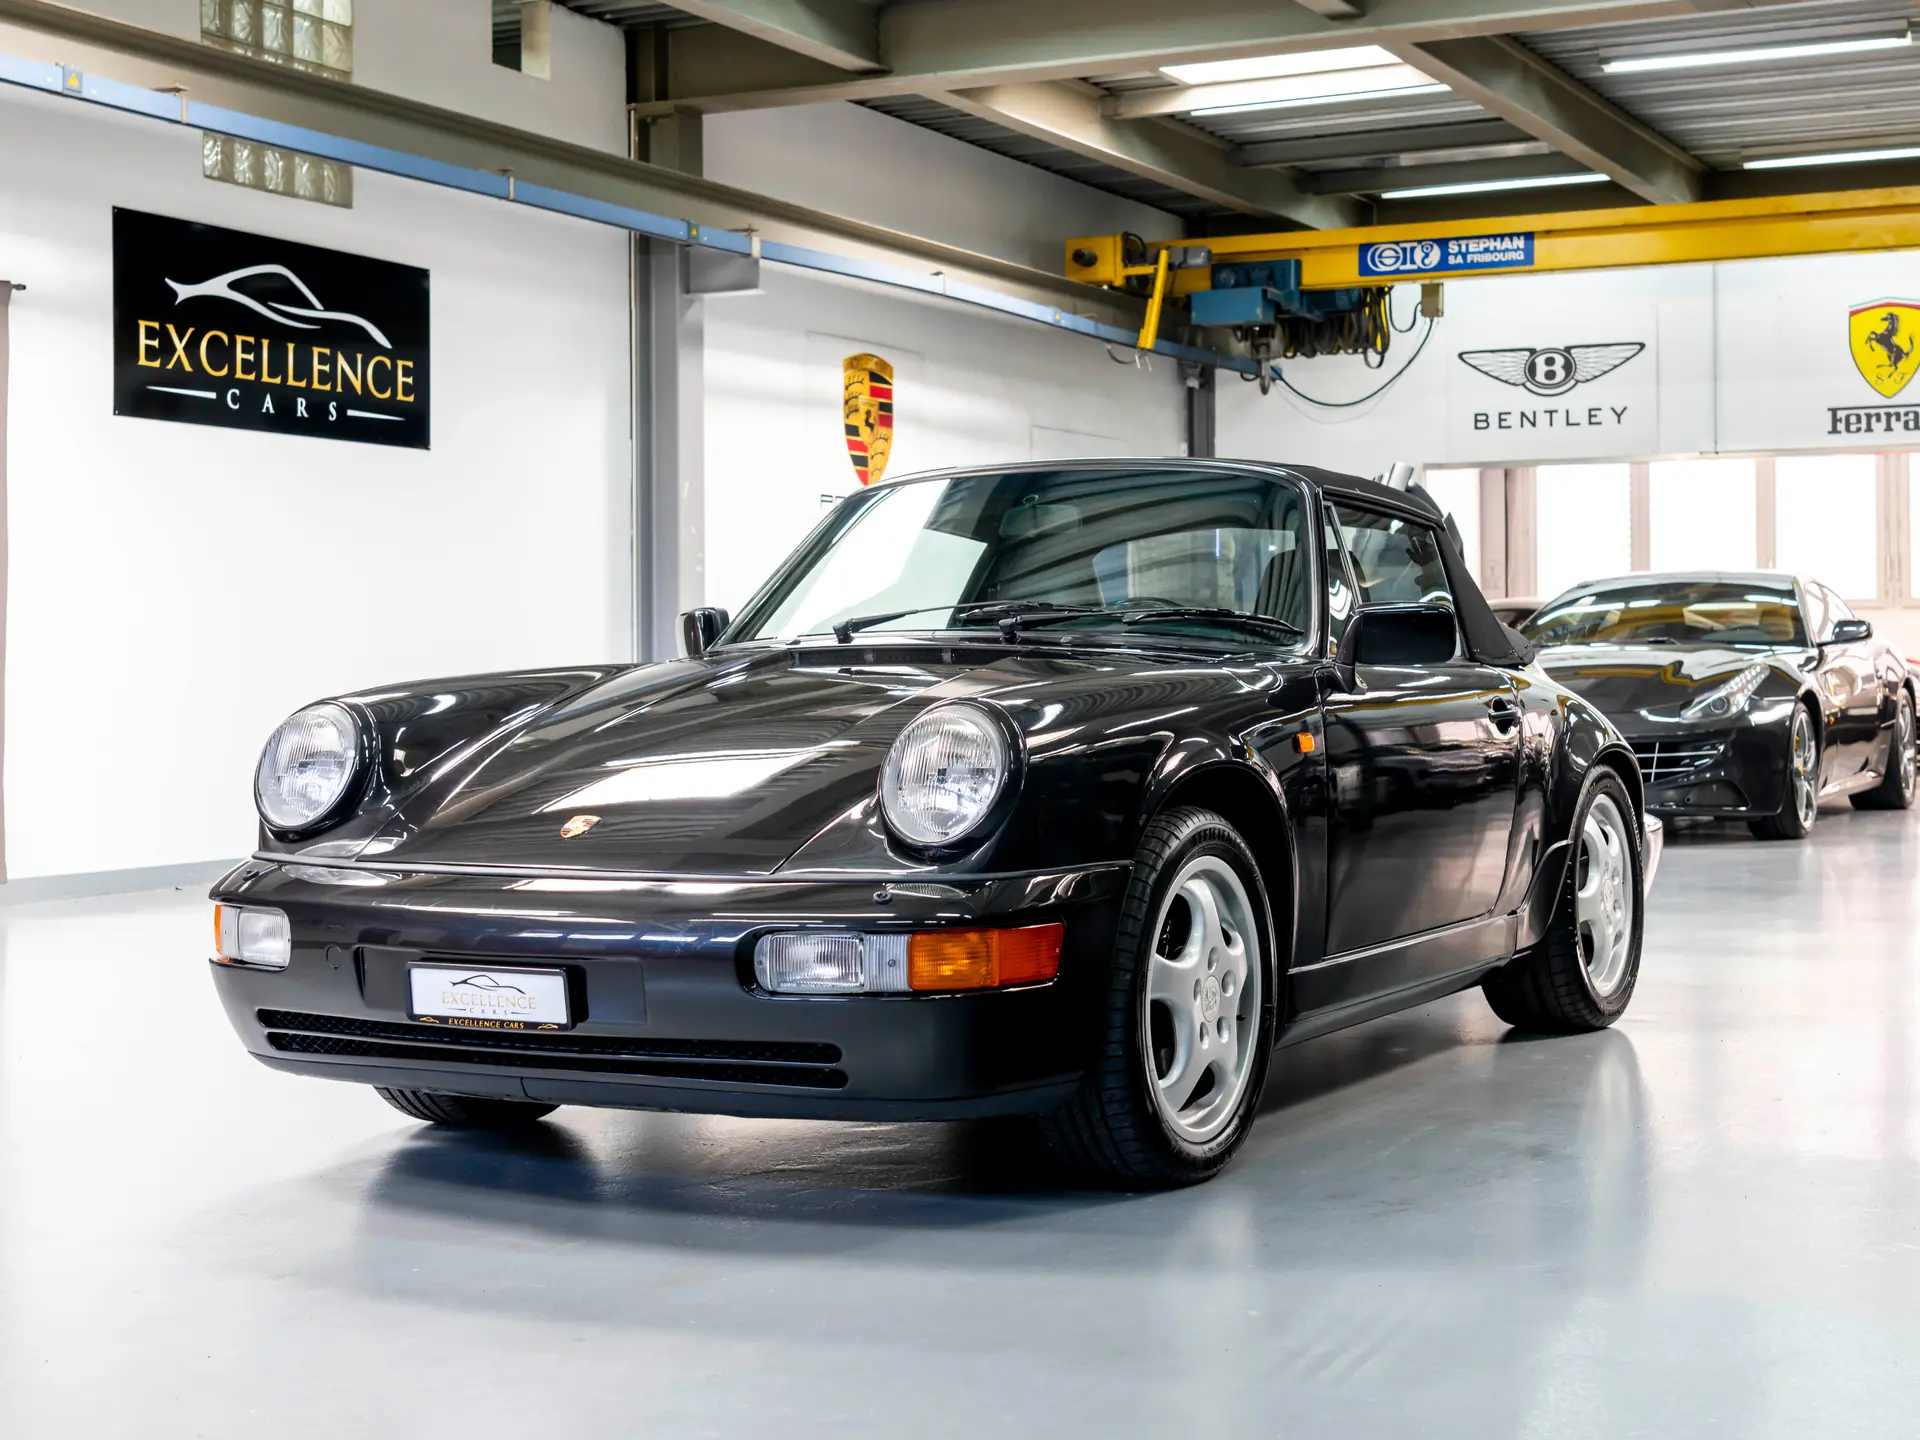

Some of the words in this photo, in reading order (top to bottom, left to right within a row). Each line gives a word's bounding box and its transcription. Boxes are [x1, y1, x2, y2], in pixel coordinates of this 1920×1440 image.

[1448, 236, 1525, 254] STEPHAN
[1448, 256, 1464, 265] SA
[1467, 250, 1525, 264] FRIBOURG
[137, 319, 415, 403] EXCELLENCE
[226, 388, 337, 421] CARS
[1473, 406, 1628, 430] BENTLEY
[441, 991, 537, 1010] EXCELLENCE
[448, 1018, 501, 1029] EXCELLENCE
[503, 1021, 525, 1030] CARS
